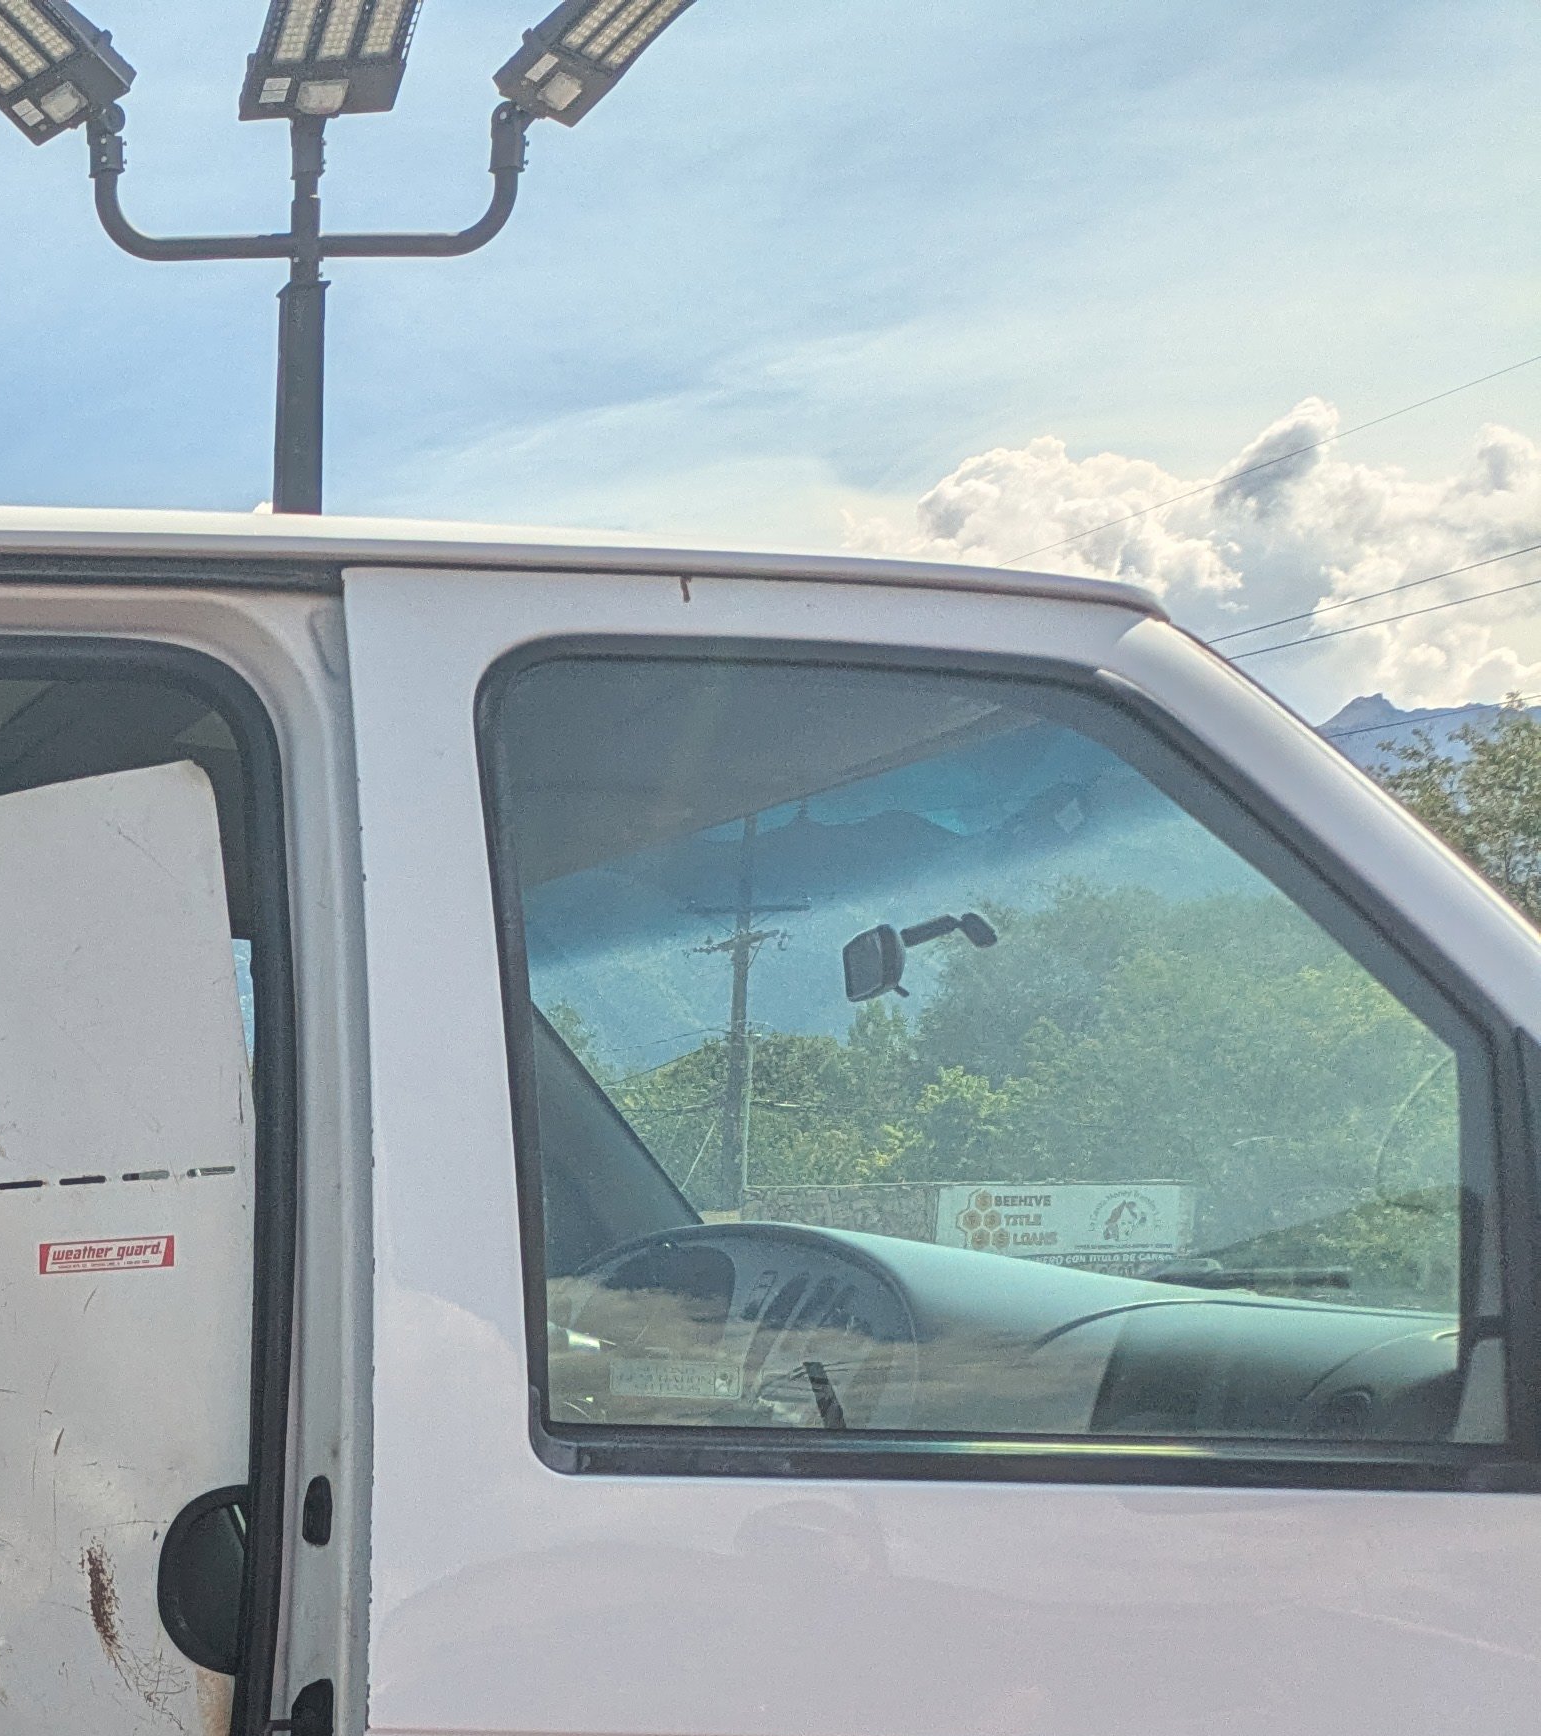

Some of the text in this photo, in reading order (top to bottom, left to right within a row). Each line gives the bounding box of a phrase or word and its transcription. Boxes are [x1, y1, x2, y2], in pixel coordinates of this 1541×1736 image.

[994, 1195, 1052, 1207] BEEHIVE
[1004, 1213, 1043, 1226] TITLE
[52, 1245, 114, 1261] weather
